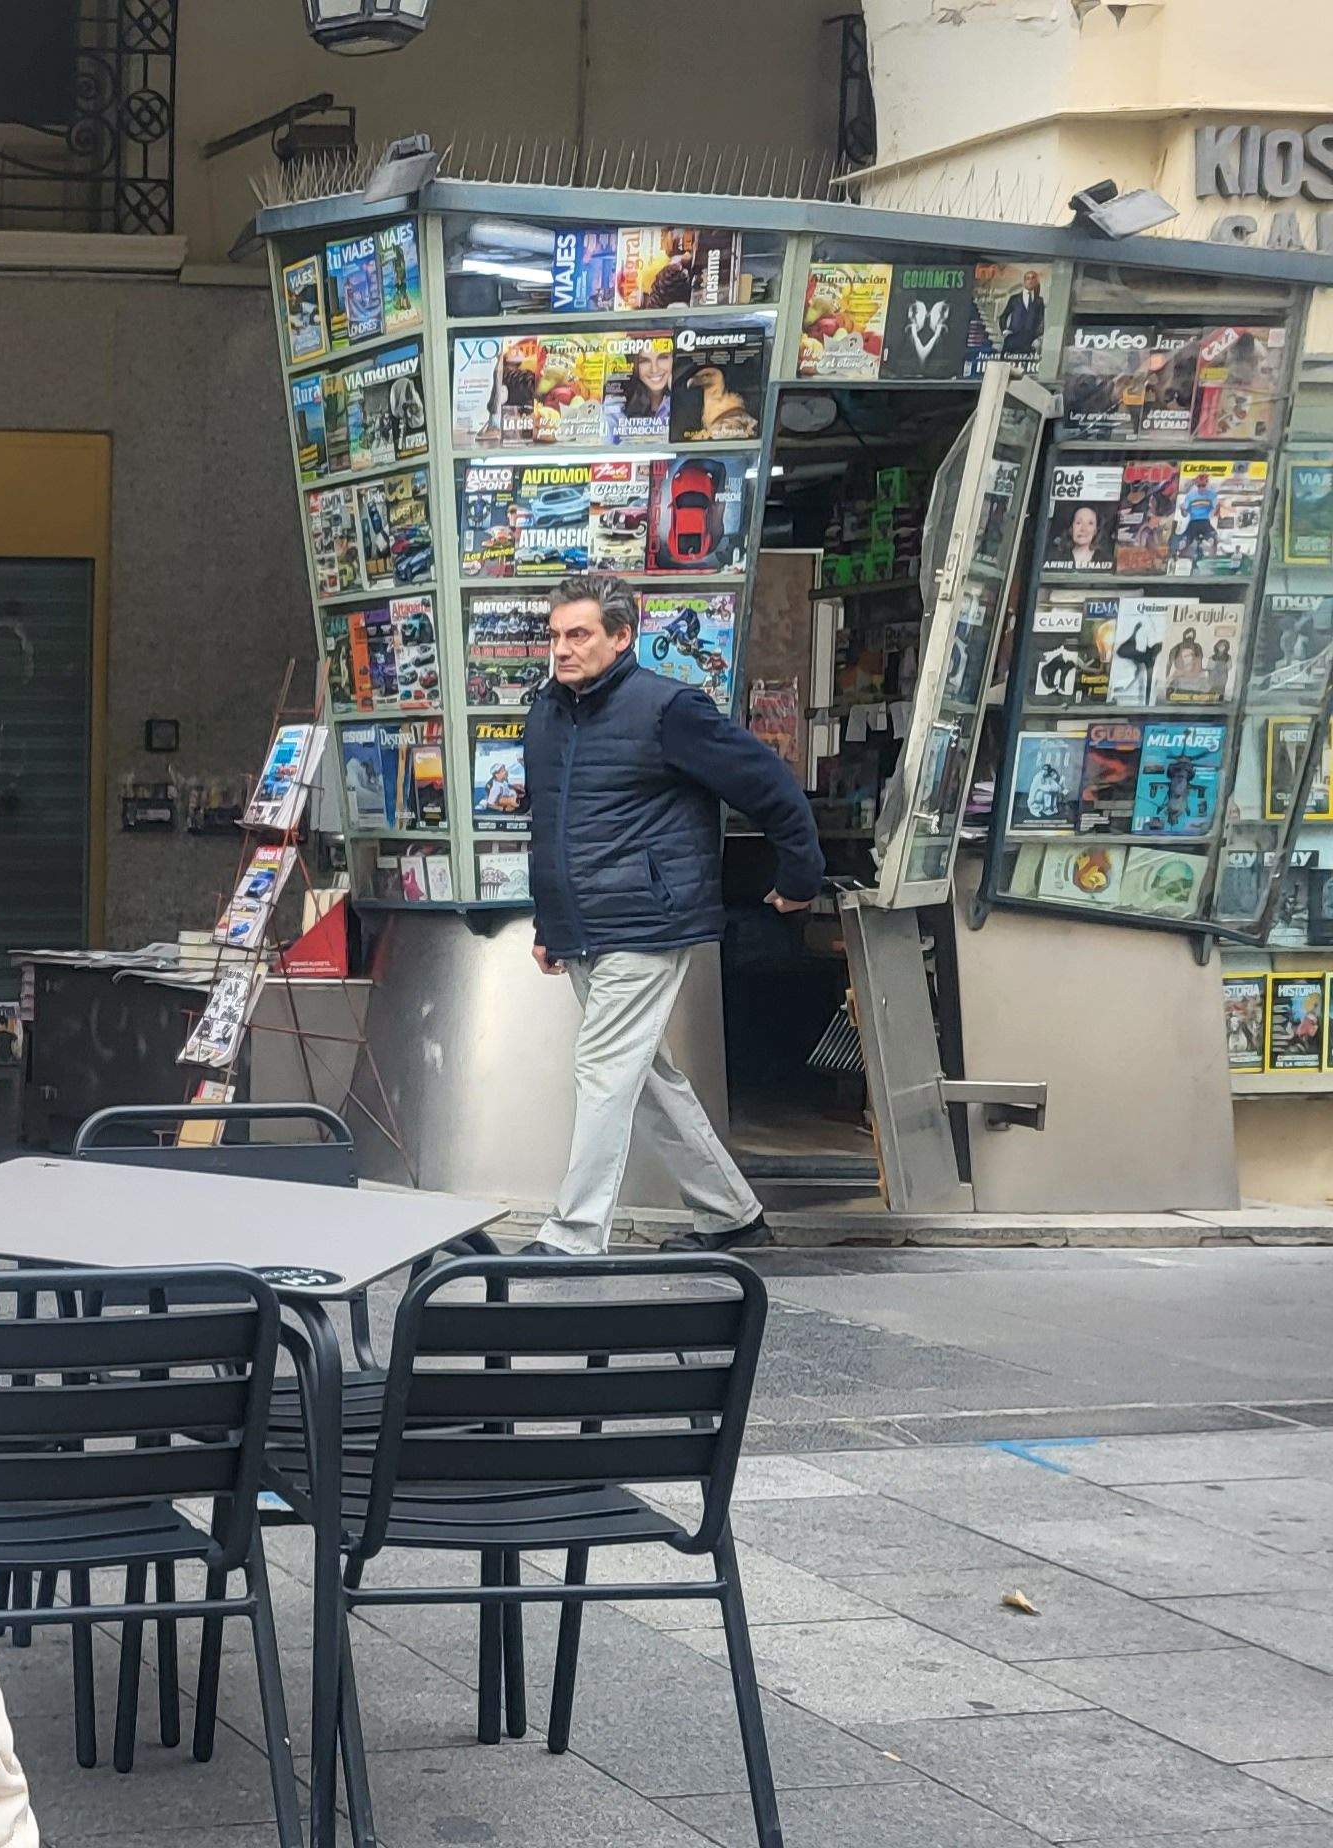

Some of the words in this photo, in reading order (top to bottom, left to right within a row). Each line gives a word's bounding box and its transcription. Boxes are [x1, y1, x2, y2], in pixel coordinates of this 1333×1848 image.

[1196, 125, 1333, 200] KIOS
[380, 223, 414, 250] VIAJES
[341, 237, 376, 263] VIAJES
[553, 234, 577, 308] VIAJES
[902, 270, 965, 289] GOURMETS
[677, 330, 746, 351] Quercus
[1074, 328, 1148, 349] trofeo
[387, 356, 420, 376] muy
[619, 417, 662, 427] ENTRENA
[466, 469, 512, 481] AUTO
[1053, 469, 1084, 486] Qué
[466, 480, 511, 493] SPORT
[473, 601, 551, 614] MOTOCICLISM
[1039, 617, 1080, 627] CLAVE
[1146, 734, 1221, 752] MILITARES
